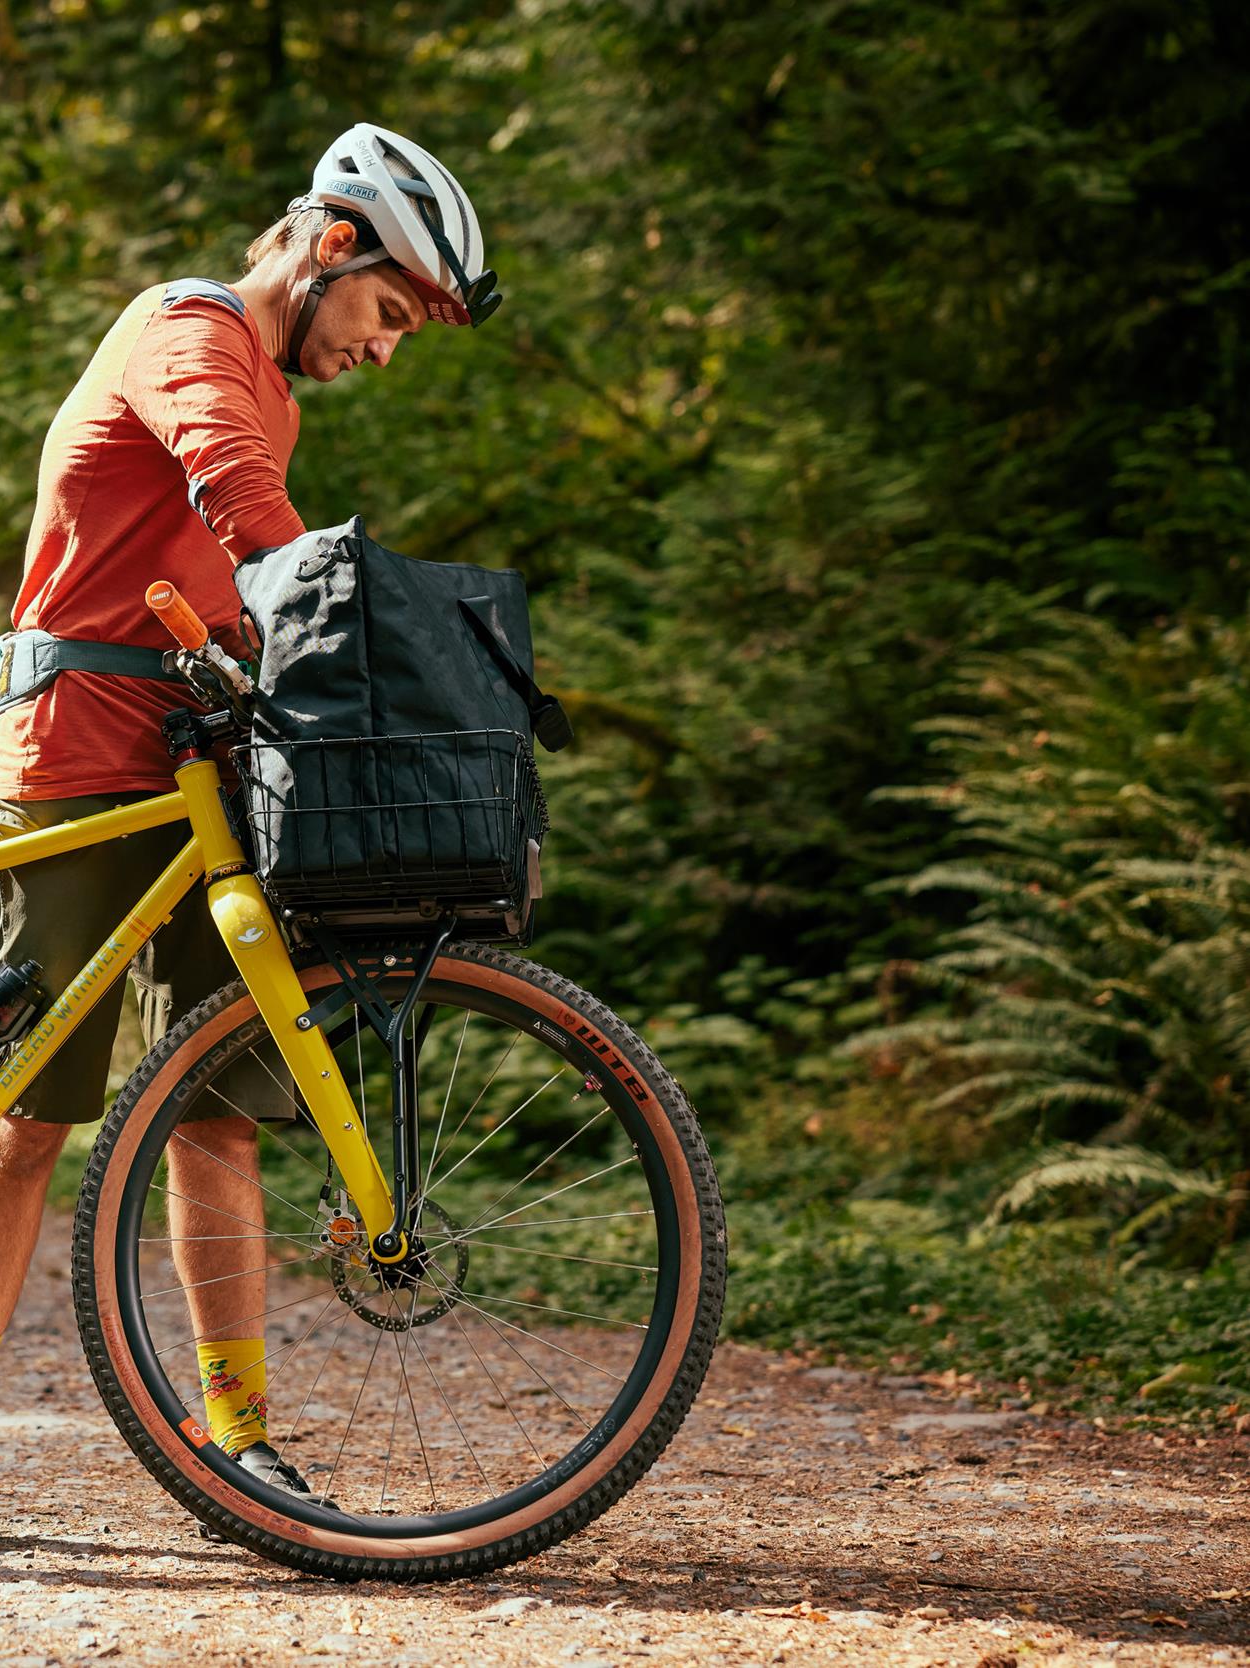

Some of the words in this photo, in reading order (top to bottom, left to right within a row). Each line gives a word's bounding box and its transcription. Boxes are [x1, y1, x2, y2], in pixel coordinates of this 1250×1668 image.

[357, 140, 377, 168] SMITH
[220, 864, 242, 877] KING
[173, 1019, 268, 1102] OUTBACK
[576, 1025, 648, 1102] WTB
[532, 1429, 604, 1490] ASTRAL
